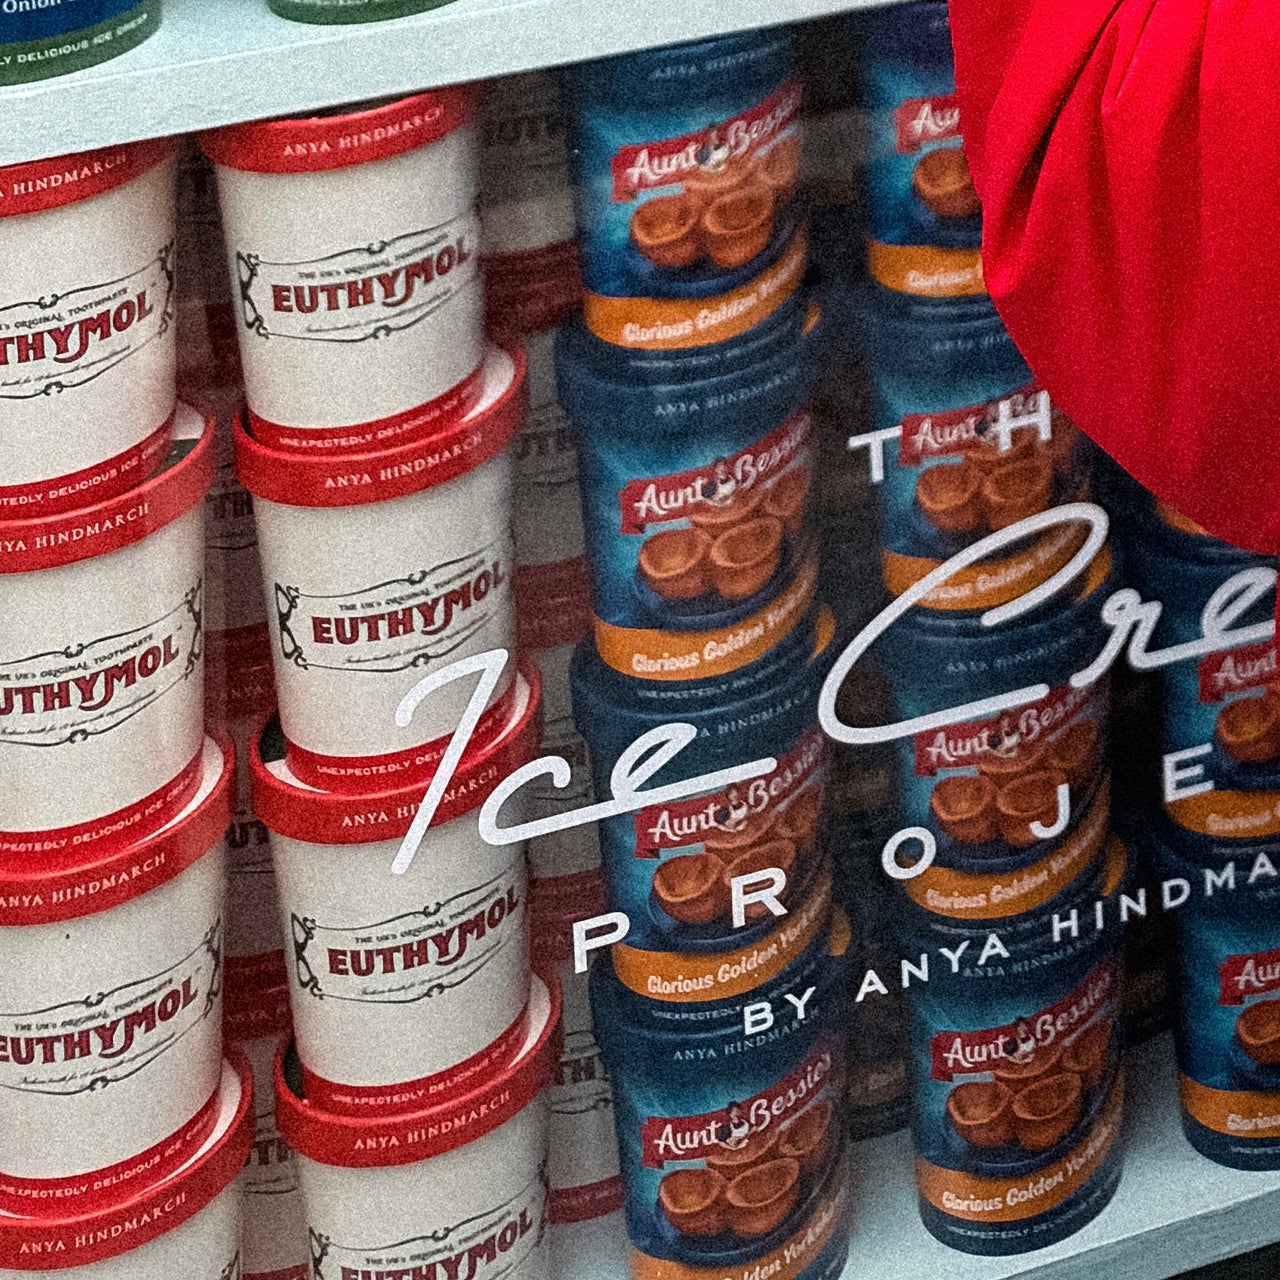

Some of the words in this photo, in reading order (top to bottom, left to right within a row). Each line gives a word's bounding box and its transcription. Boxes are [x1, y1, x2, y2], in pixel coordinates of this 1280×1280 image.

[282, 141, 332, 157] ANYA
[339, 105, 446, 150] HINDMARCH
[12, 152, 128, 196] HINDMARCH
[627, 146, 698, 186] Aunt
[270, 235, 472, 314] EUTHYMOL
[0, 289, 154, 366] THYMOL
[849, 391, 1051, 484] TH
[910, 416, 976, 449] Aunt
[48, 467, 118, 499] DELICIOUS
[323, 472, 373, 489] ANYA
[379, 431, 483, 482] HINDMARCH
[634, 478, 706, 518] Aunt
[34, 501, 151, 547] HINDMARCH
[310, 560, 506, 645] EUTHYMOL
[631, 653, 700, 673] Glorious
[703, 619, 764, 661] Golden
[0, 634, 181, 716] UTHYMOL
[394, 647, 778, 874] Ice
[818, 501, 1278, 744] Cre
[316, 761, 411, 776] UNEXPECTEDLY
[926, 730, 991, 763] Aunt
[72, 812, 142, 846] DELICIOUS
[341, 809, 391, 829] ANYA
[647, 802, 718, 844] Aunt
[51, 851, 167, 904] HINDMARCH
[572, 742, 1214, 975] PROJE
[326, 885, 520, 978] EUTHYMOL
[743, 986, 818, 1036] BY
[854, 932, 1011, 1003] ANYA
[1051, 851, 1279, 943] HINDMA
[647, 970, 714, 996] Glorious
[716, 942, 778, 984] Golden
[672, 1048, 717, 1062] ANYA
[943, 1035, 1007, 1067] Aunt
[330, 1089, 424, 1106] UNEXPECTEDLY
[354, 1137, 401, 1151] ANYA
[407, 1090, 512, 1143] HINDMARCH
[654, 1121, 722, 1155] Aunt
[93, 1155, 161, 1190] DELICIOUS
[942, 1191, 1003, 1212] Glorious
[1006, 1173, 1064, 1207] Golden
[19, 1239, 66, 1254] ANYA
[75, 1191, 187, 1248] HINDMARCH
